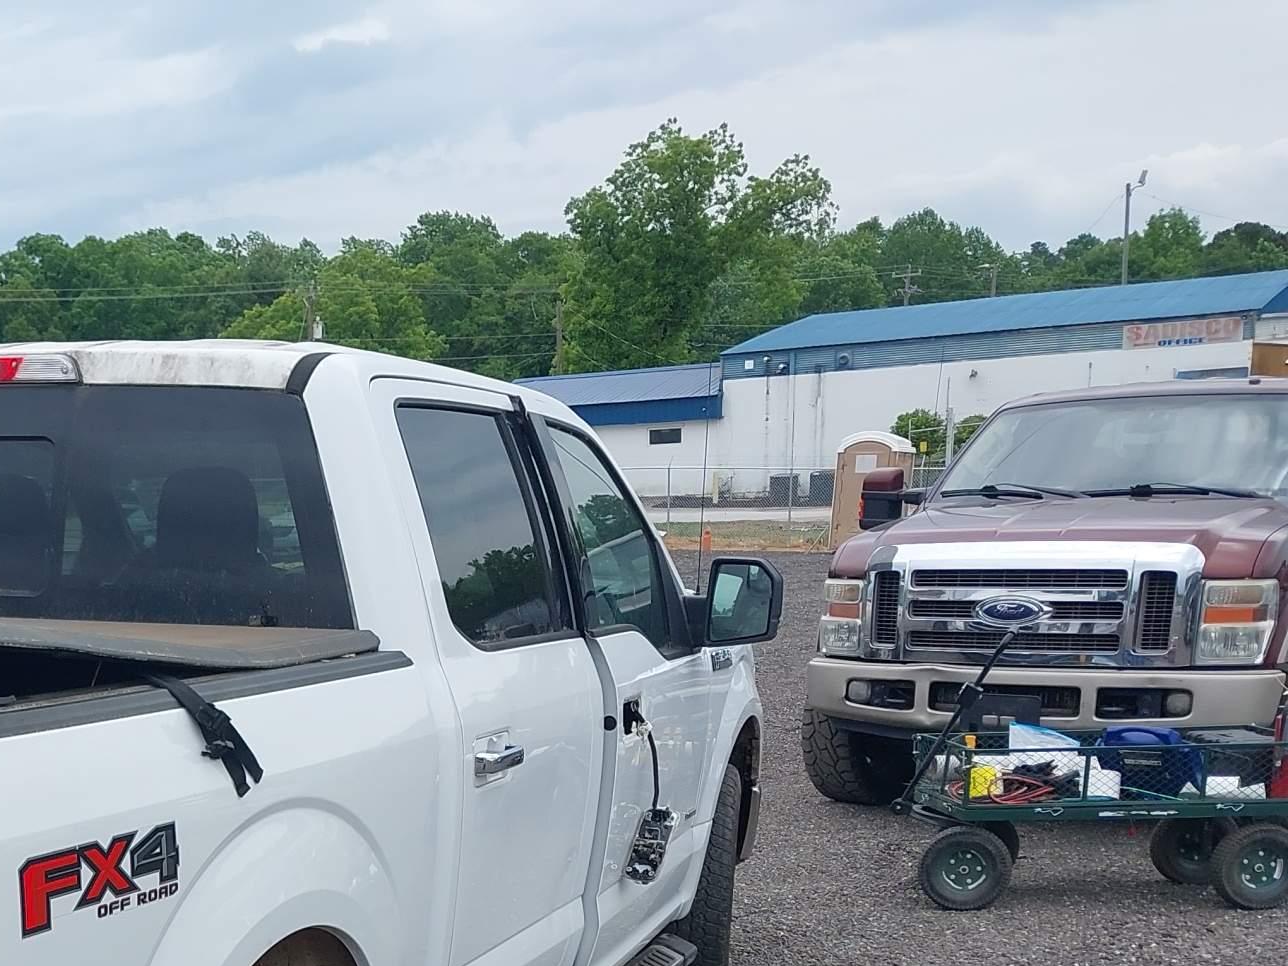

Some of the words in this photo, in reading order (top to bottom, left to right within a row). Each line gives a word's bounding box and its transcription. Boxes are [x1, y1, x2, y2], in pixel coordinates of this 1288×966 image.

[18, 821, 179, 940] FX4
[97, 896, 131, 918] OFF
[137, 882, 179, 906] ROAD
